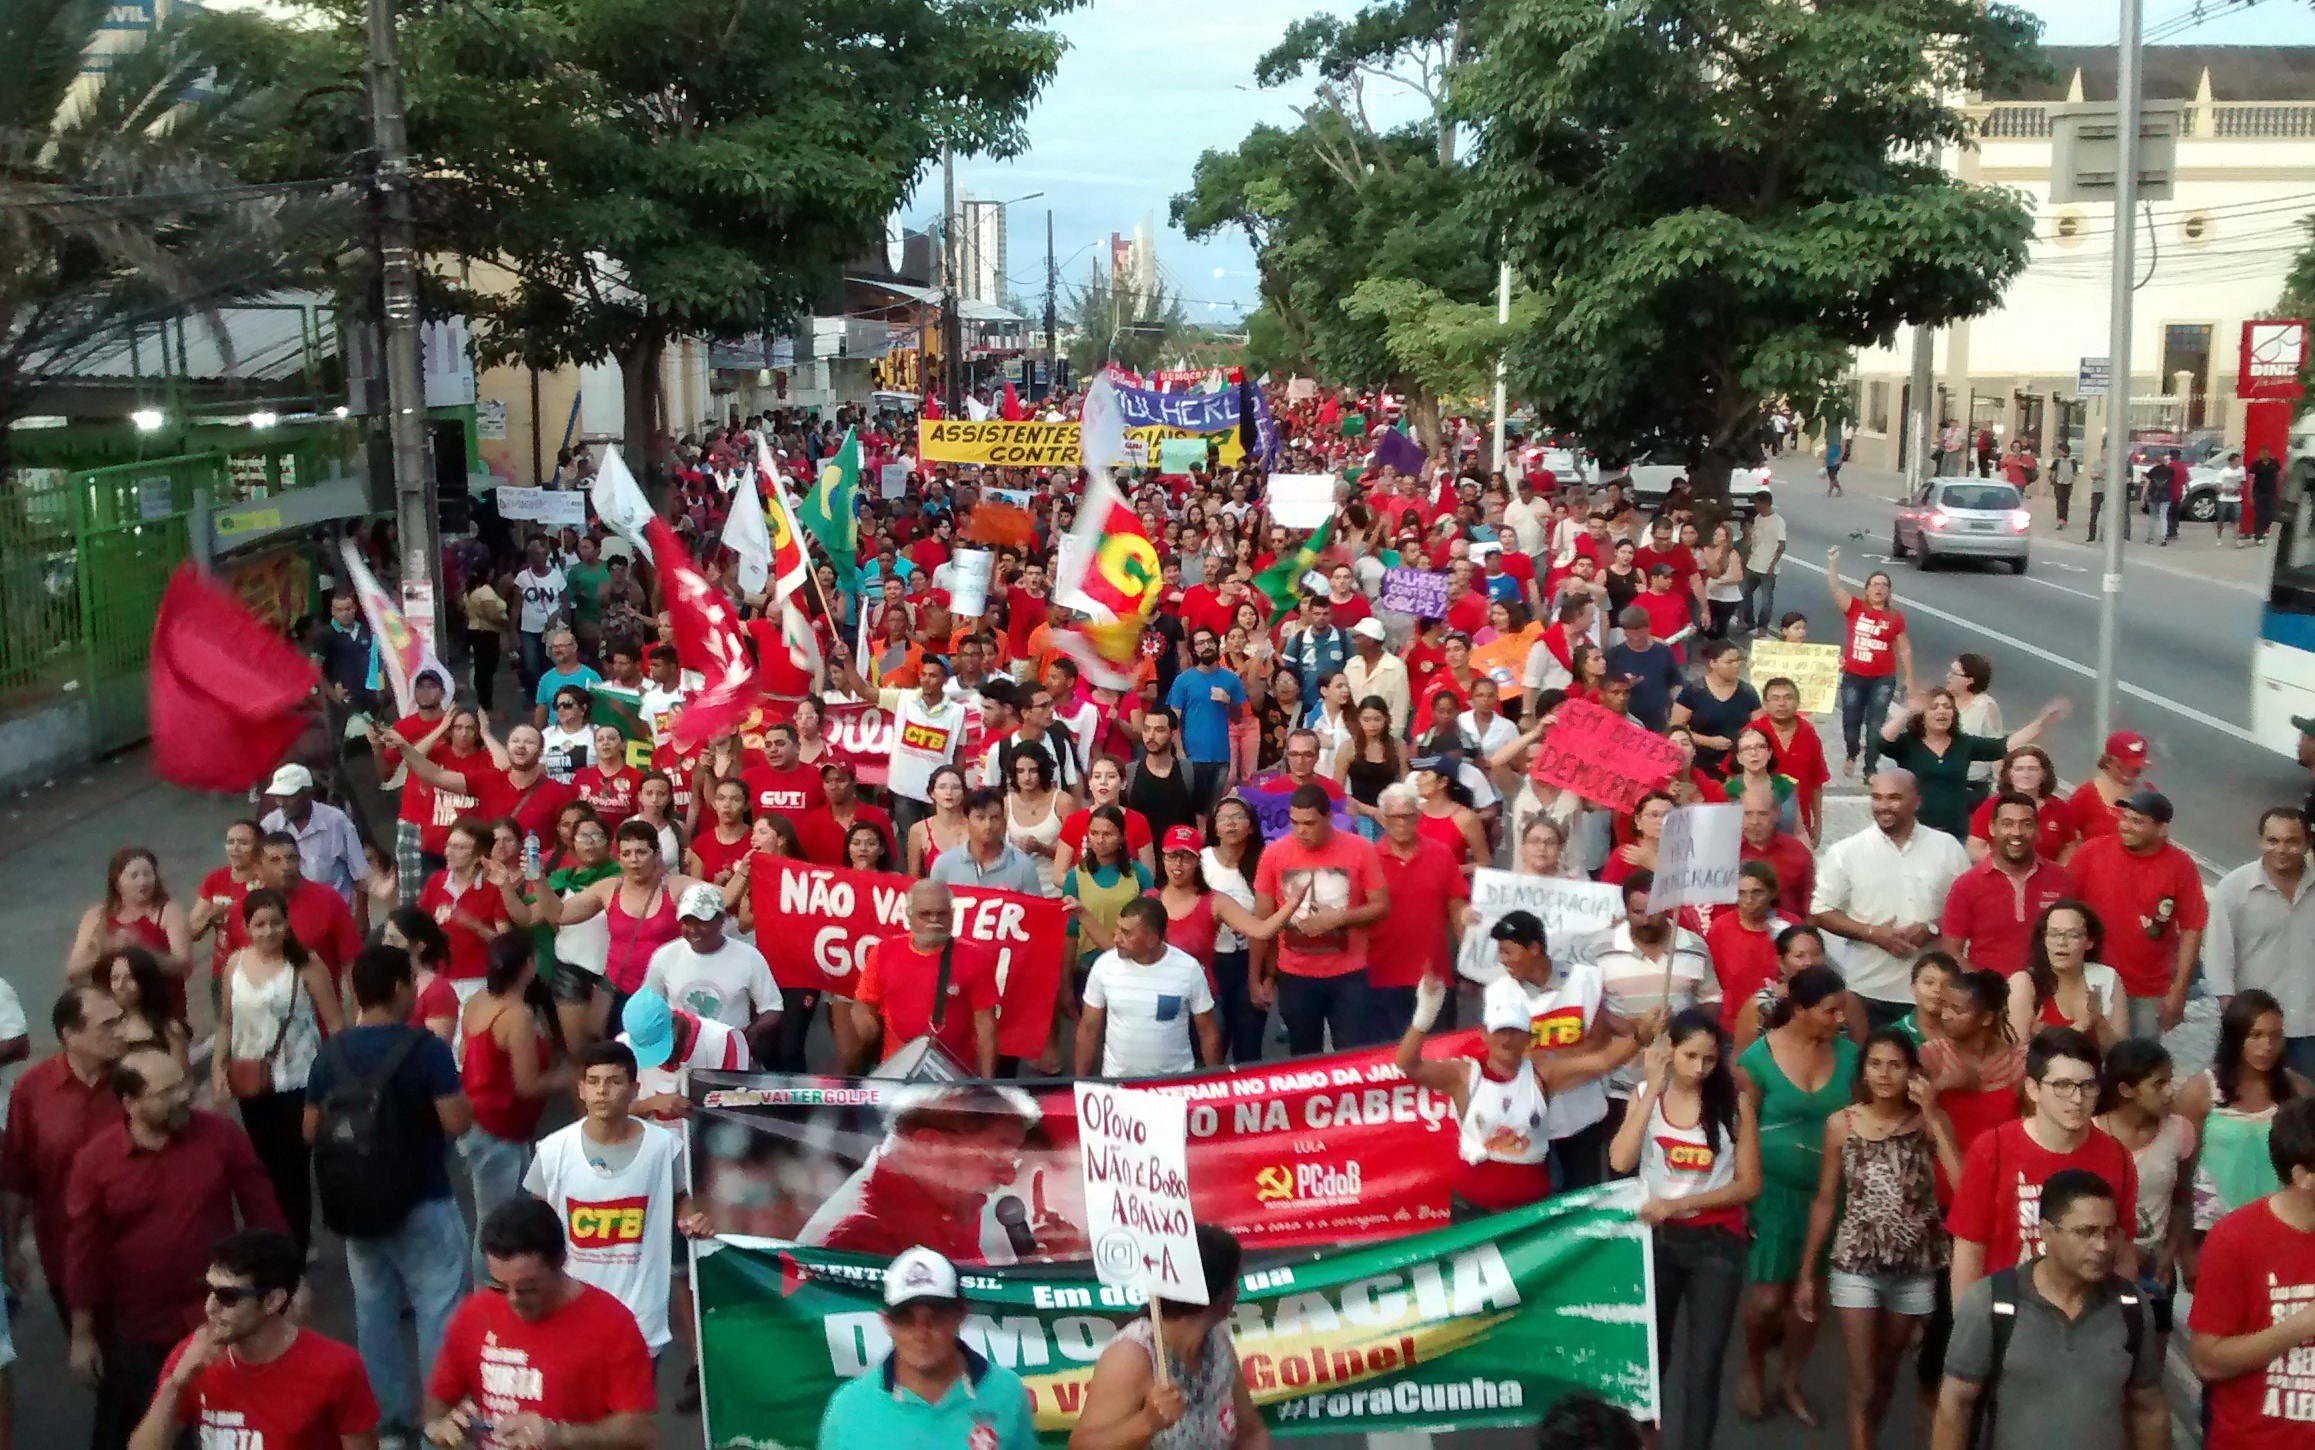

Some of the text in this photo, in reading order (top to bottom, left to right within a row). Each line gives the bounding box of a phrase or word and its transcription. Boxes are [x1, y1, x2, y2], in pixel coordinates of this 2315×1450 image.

[930, 424, 1082, 444] ASSISTENTES
[989, 446, 1084, 463] CONTR
[525, 586, 555, 603] ON
[905, 726, 946, 749] CTB
[780, 867, 1030, 942] NÃO VA TER
[1233, 1076, 1265, 1097] NO
[1331, 1065, 1363, 1086] DA
[1233, 1100, 1291, 1135] NA
[1304, 1085, 1458, 1132] CABEÇ
[1087, 1144, 1132, 1187] NÃO
[1669, 1145, 1714, 1167] CTB
[1296, 1159, 1362, 1199] PCdoB
[571, 1206, 645, 1240] CTB
[797, 1263, 888, 1282] FRENT
[1033, 1285, 1093, 1310] Em
[824, 1242, 1523, 1378] DMORACIA
[1242, 1336, 1418, 1392] Golpe!
[1276, 1376, 1523, 1421] #ForaCunha
[2284, 1390, 2315, 1422] LE
